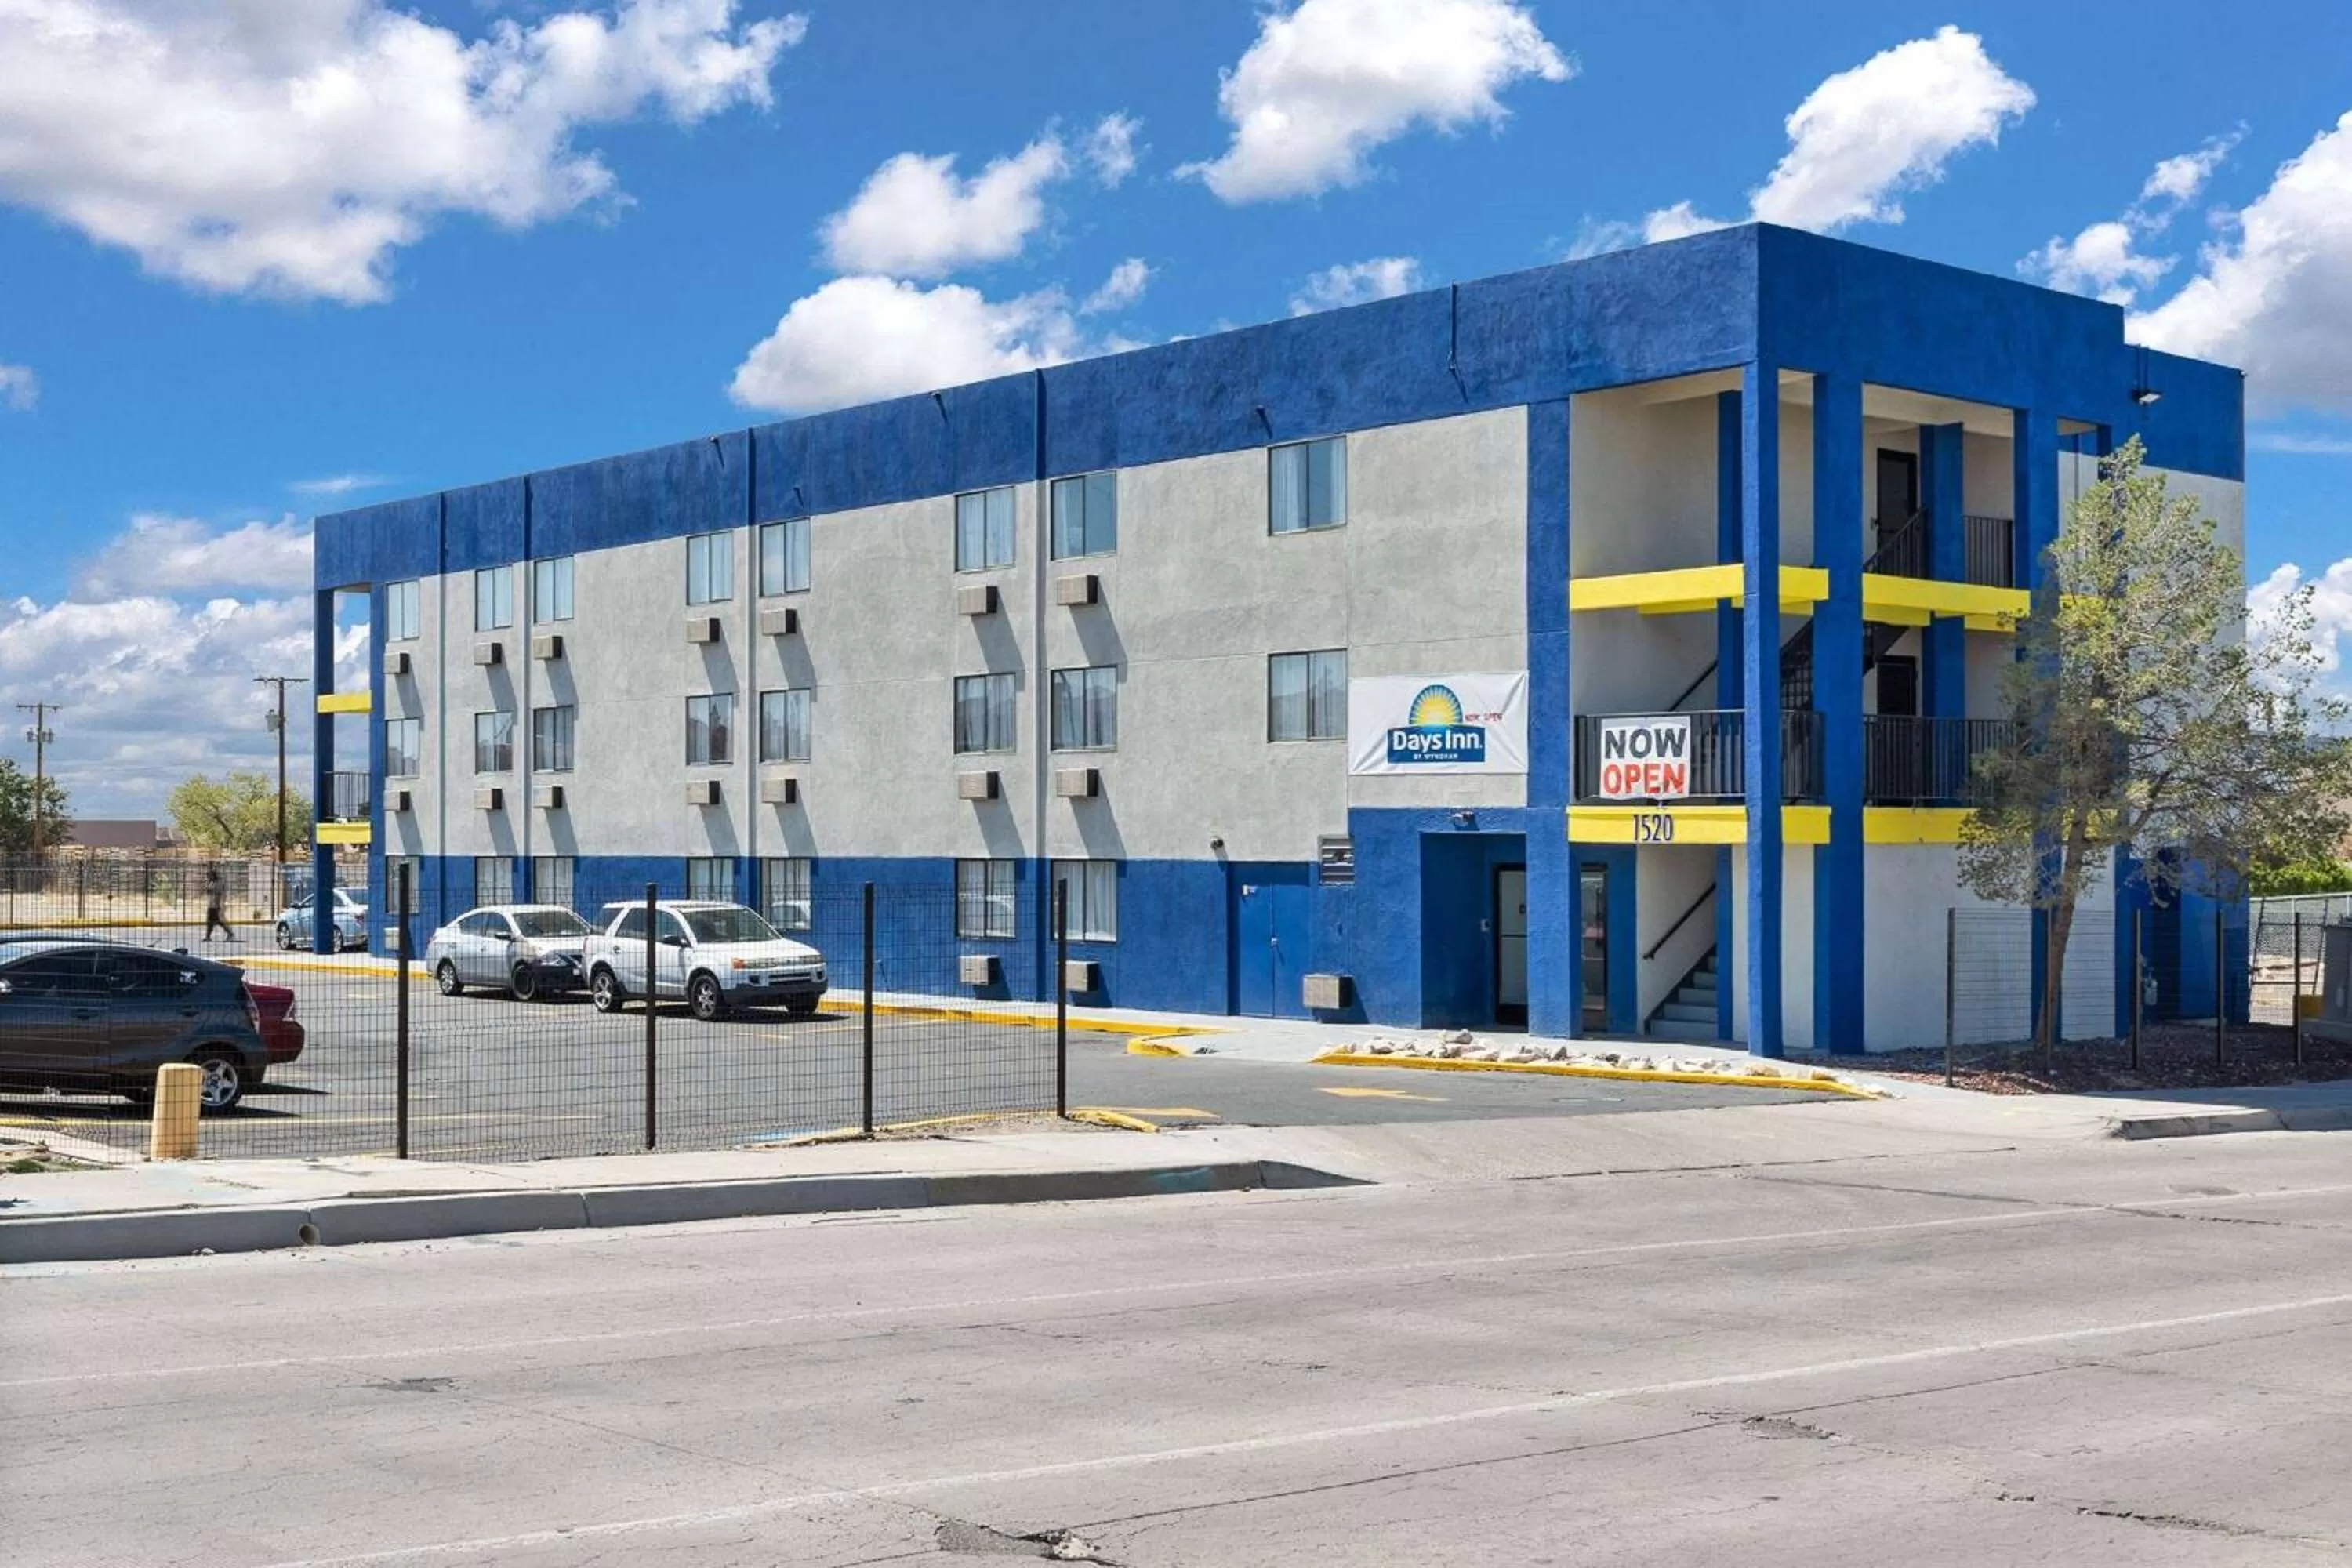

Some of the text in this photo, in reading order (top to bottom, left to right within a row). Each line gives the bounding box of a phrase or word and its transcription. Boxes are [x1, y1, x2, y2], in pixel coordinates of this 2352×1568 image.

[1393, 731, 1442, 753] Days
[1605, 728, 1687, 759] NOW
[1603, 764, 1685, 794] OPEN
[1633, 814, 1674, 841] 1520
